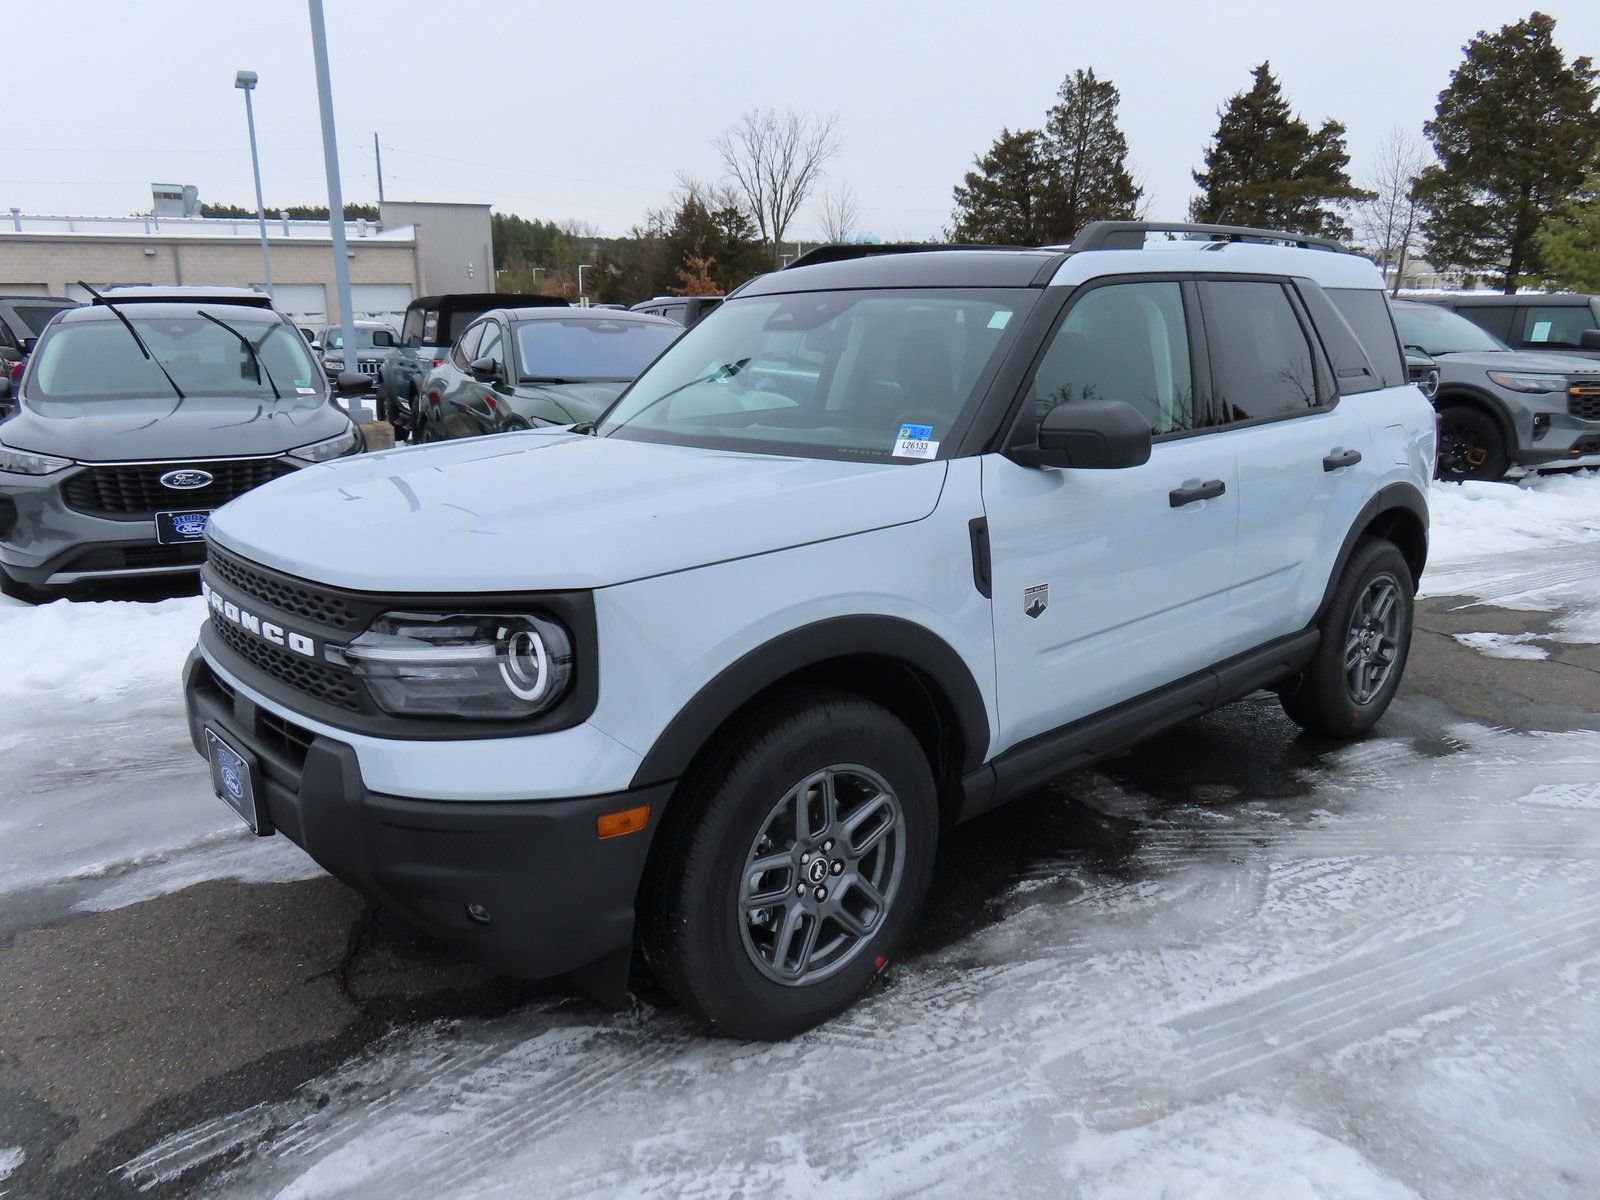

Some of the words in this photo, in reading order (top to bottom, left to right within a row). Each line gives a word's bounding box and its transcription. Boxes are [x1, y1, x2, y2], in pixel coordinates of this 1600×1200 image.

[901, 429, 908, 438] 2
[901, 441, 929, 450] L26133
[173, 513, 208, 525] JERRY
[182, 523, 203, 532] Ford
[202, 581, 315, 657] BRONCO
